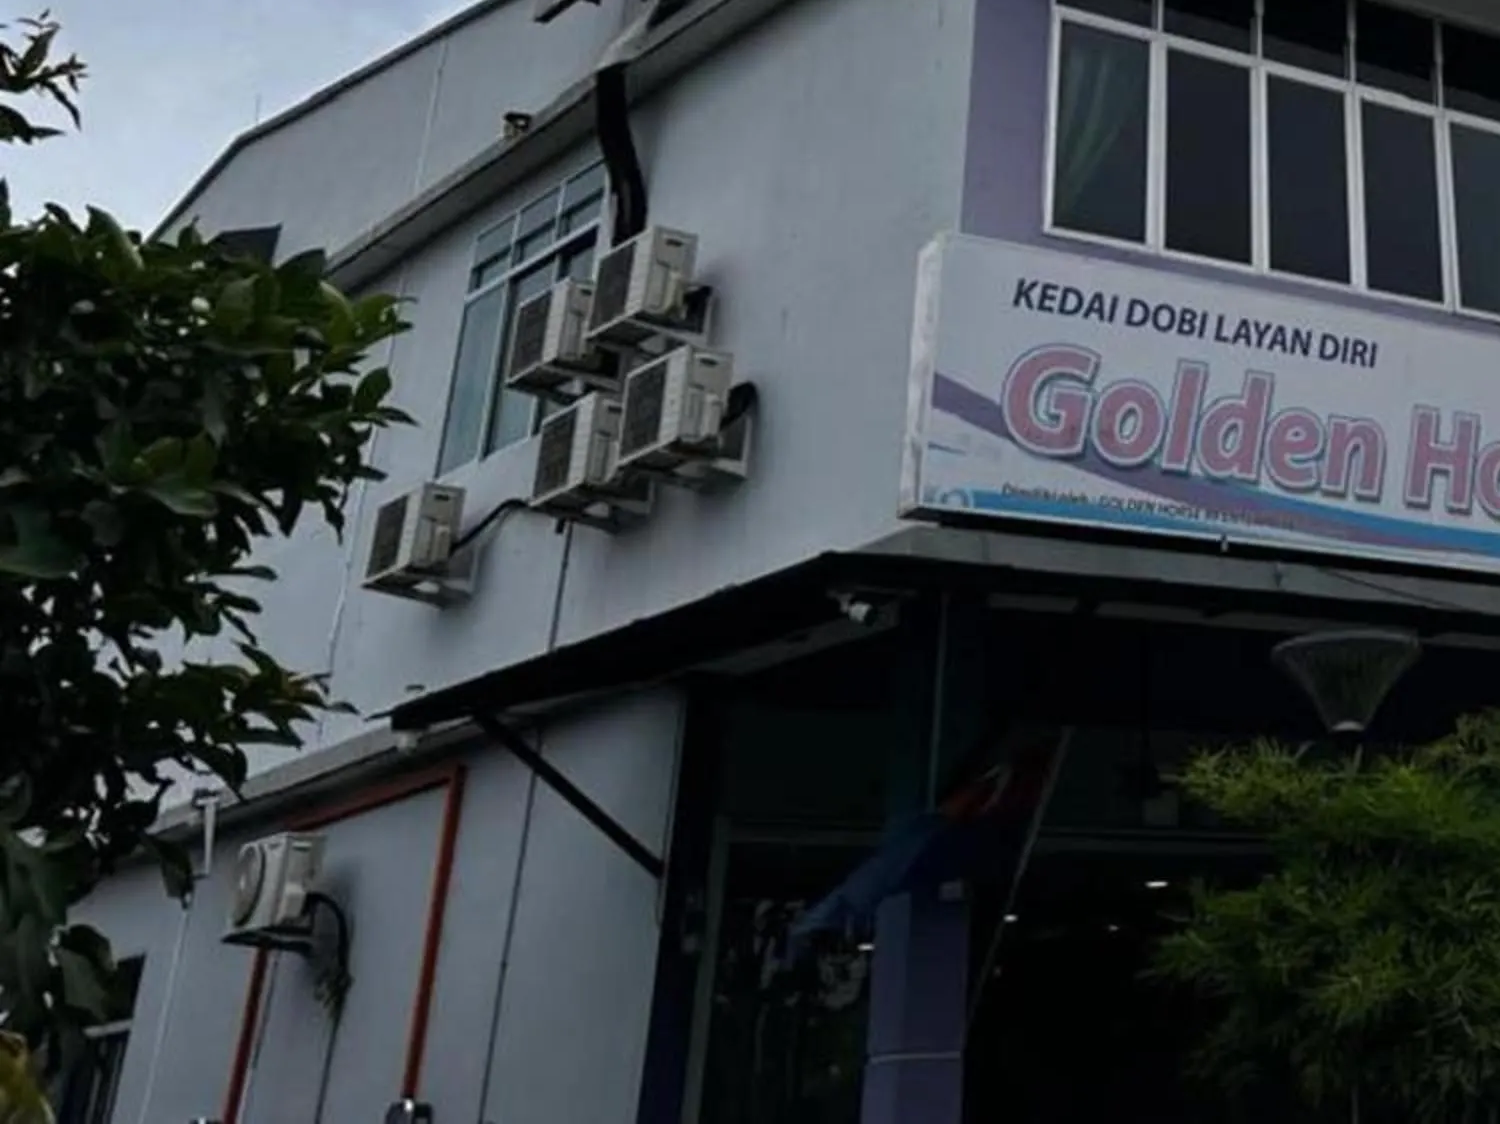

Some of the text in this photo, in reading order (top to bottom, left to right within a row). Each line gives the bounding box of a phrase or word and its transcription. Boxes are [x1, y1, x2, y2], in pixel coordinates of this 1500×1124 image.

[1012, 278, 1378, 369] KEDAI DOBI LAYAN DIRI
[1002, 342, 1388, 503] Golden
